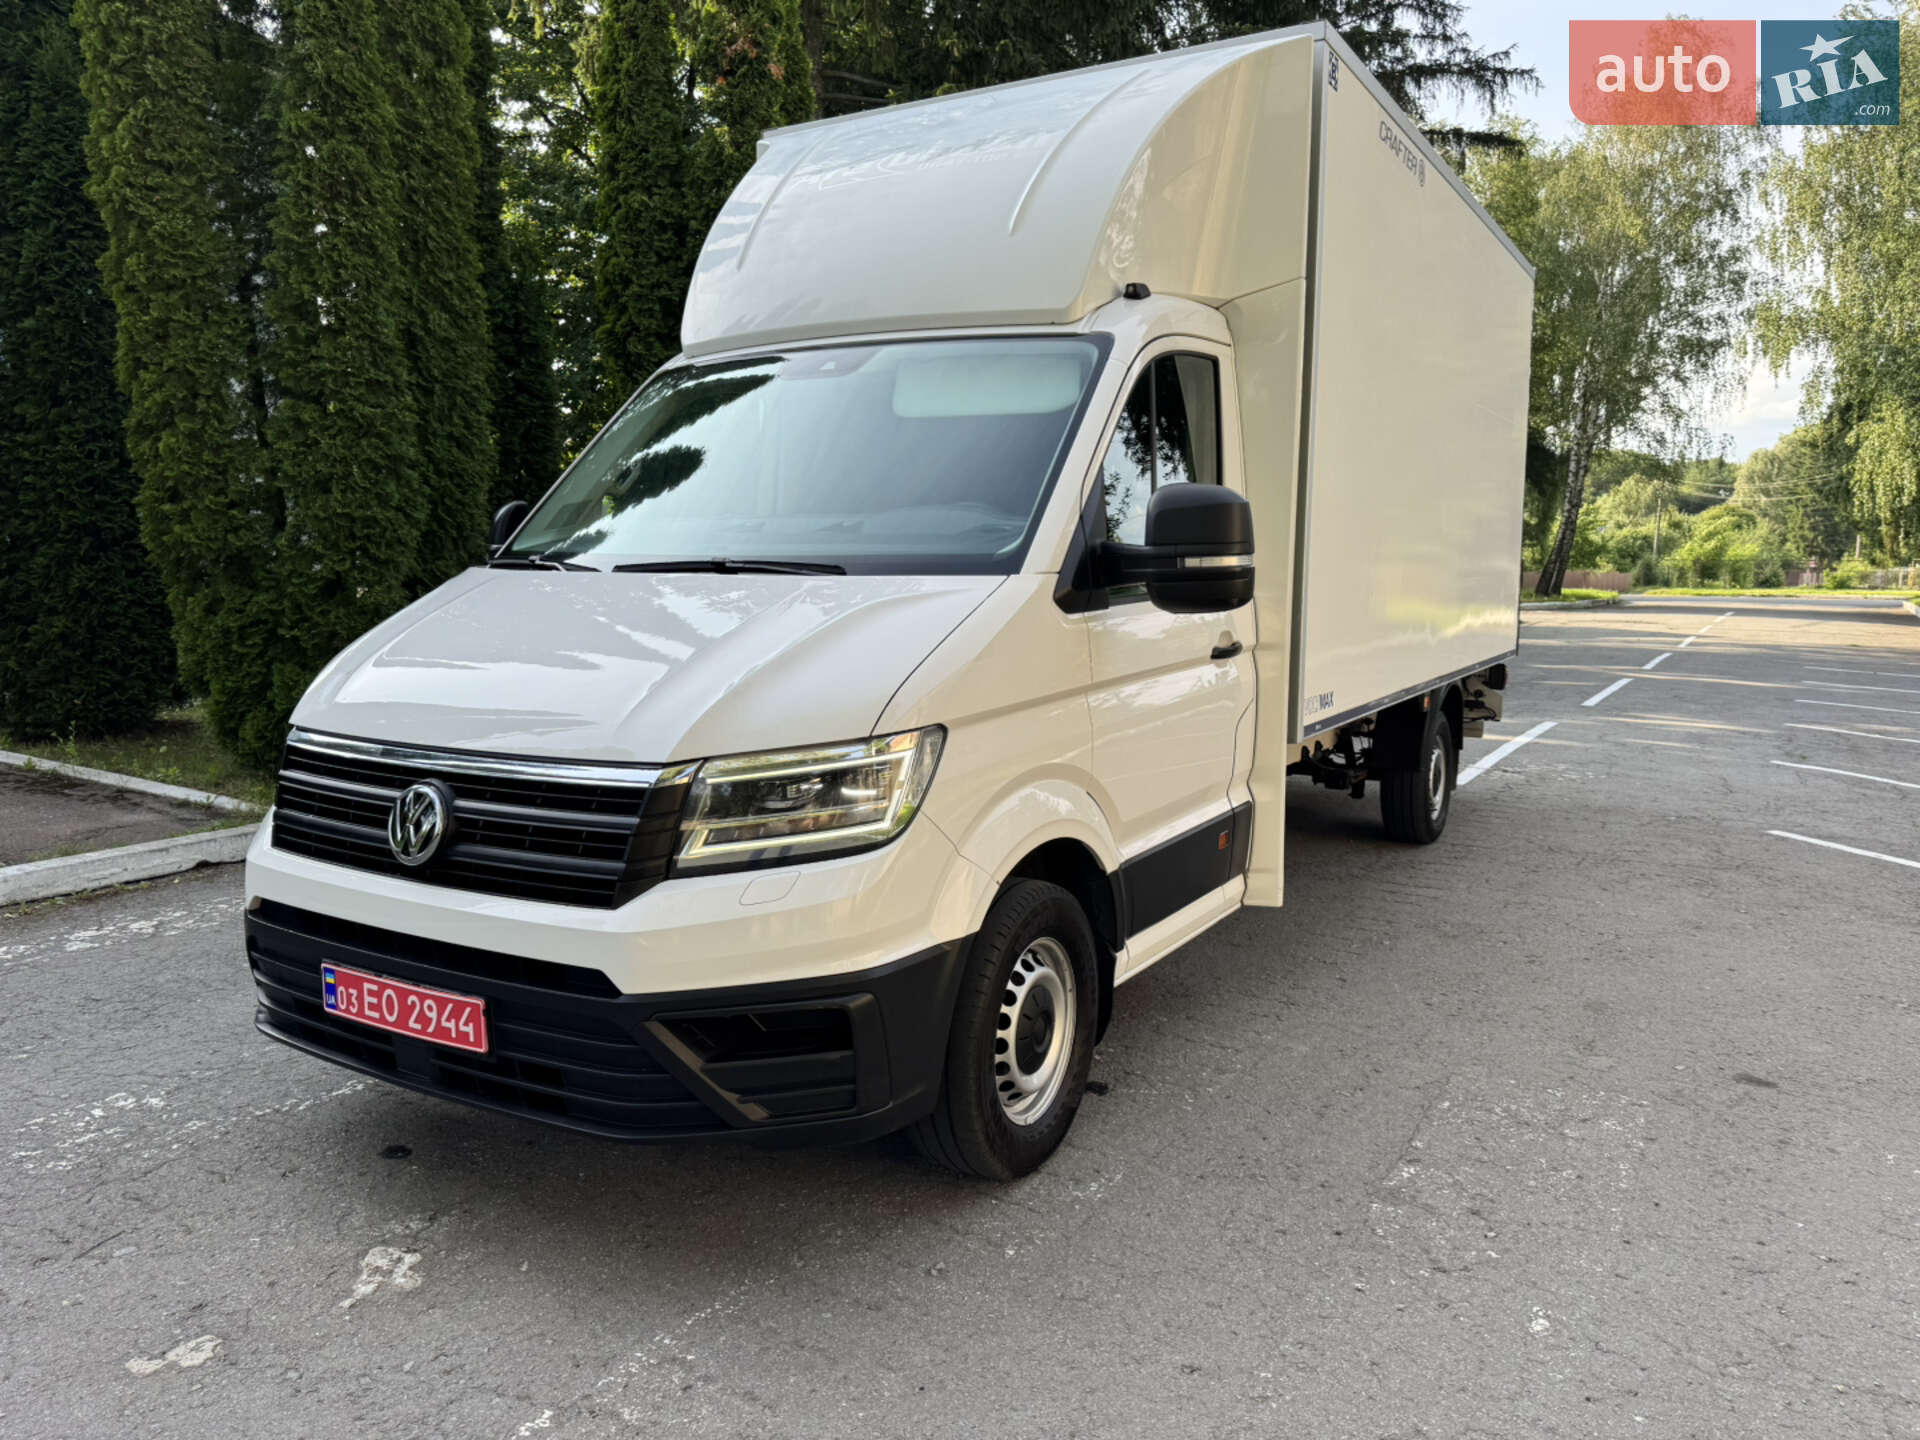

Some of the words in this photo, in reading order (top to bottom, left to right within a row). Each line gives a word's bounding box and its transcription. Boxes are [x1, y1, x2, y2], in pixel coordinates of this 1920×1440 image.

[1379, 121, 1417, 176] CRAFTER
[337, 985, 359, 1014] 03
[363, 982, 399, 1023] EO
[407, 995, 475, 1042] 2944
